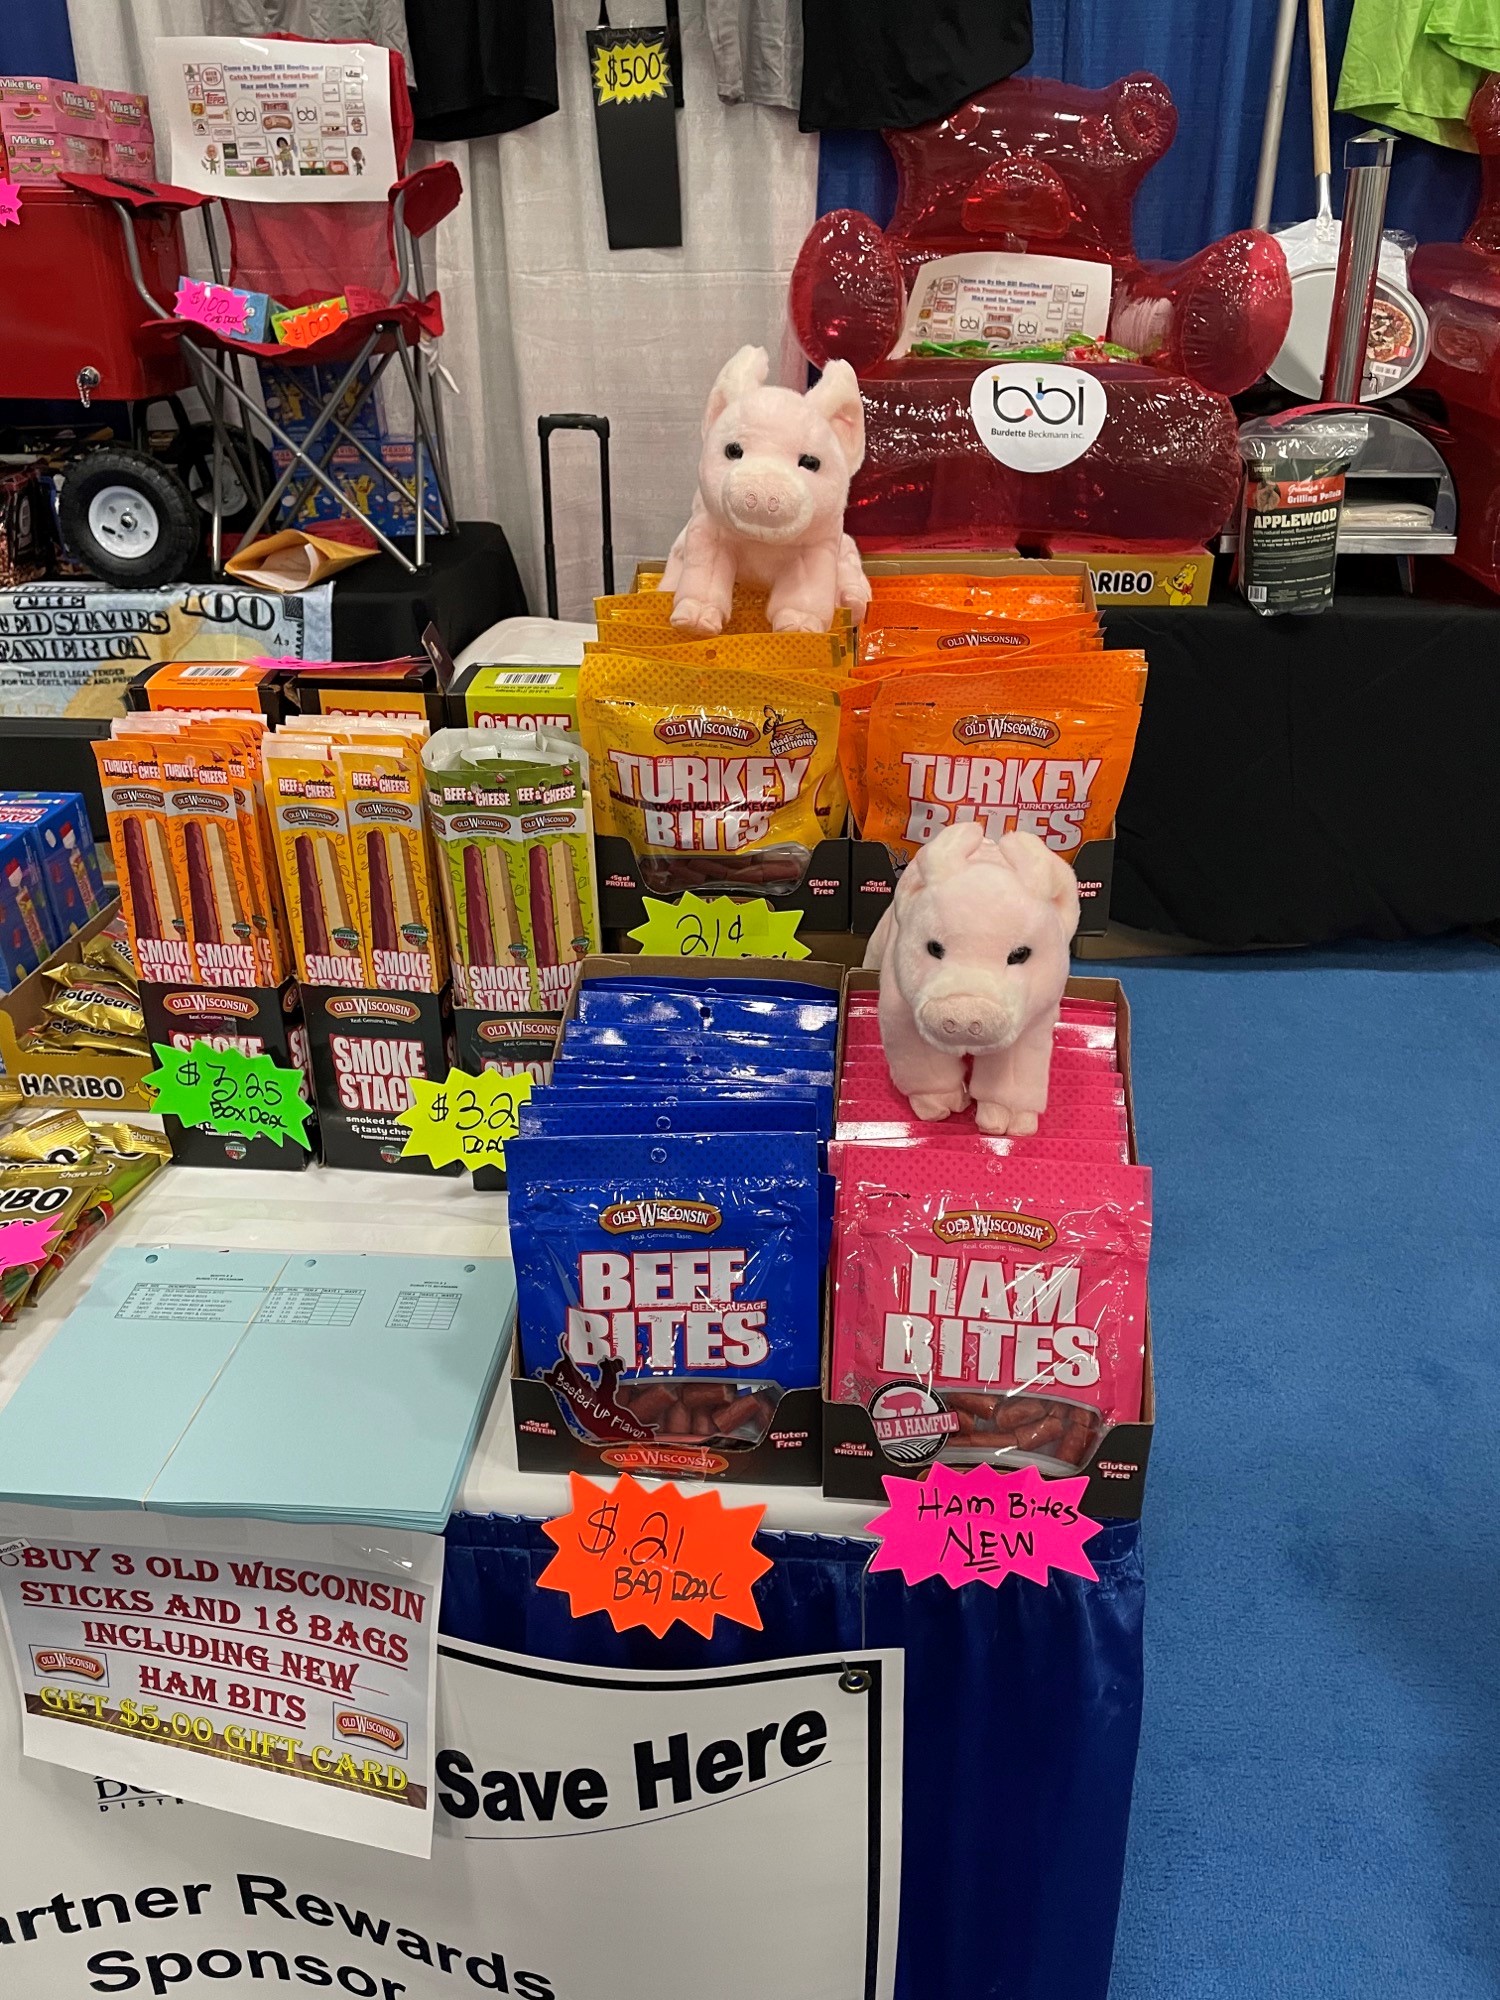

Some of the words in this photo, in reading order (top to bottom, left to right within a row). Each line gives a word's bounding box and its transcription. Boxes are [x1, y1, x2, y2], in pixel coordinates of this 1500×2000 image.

[605, 52, 661, 91] $500
[12, 136, 36, 146] Mike
[991, 375, 1086, 426] bbi
[991, 428, 1026, 438] Burdette
[1028, 430, 1068, 438] Beckmann
[1070, 431, 1084, 439] inc.
[1288, 495, 1317, 504] Grilling
[1320, 490, 1341, 500] Pellets
[1254, 508, 1338, 528] APPLEWOOD
[13, 595, 86, 610] THE
[180, 588, 275, 630] 100
[10, 637, 151, 661] AMERICA
[948, 636, 964, 646] OLD
[965, 634, 1020, 646] WISCONSIN
[666, 724, 686, 736] OLD
[687, 718, 748, 740] WISCONSIN
[770, 734, 794, 748] Made
[795, 732, 814, 740] with
[965, 724, 986, 736] OLD
[987, 718, 1049, 740] WISCONSIN
[772, 744, 792, 756] REAL
[791, 738, 817, 748] HONEY
[352, 772, 372, 787] BEEF
[379, 779, 410, 793] CHEESE
[610, 751, 810, 803] TURKEY
[903, 753, 1101, 804] TURKEY
[279, 779, 298, 792] BEEF
[306, 786, 336, 799] CHEESE
[444, 788, 466, 801] BEEF
[476, 793, 511, 806] CHEESE
[1053, 802, 1090, 810] SAUSAGE
[646, 810, 772, 852] BITES
[903, 800, 1085, 850] BITES
[606, 880, 636, 888] PROTEIN
[808, 879, 839, 887] Gluten
[814, 887, 834, 895] Free
[195, 942, 256, 969] SMOKE
[373, 950, 432, 977] SMOKE
[201, 969, 257, 987] STACK
[306, 954, 364, 981] SMOKE
[468, 966, 531, 991] SMOKE
[377, 974, 431, 993] STACK
[172, 998, 190, 1009] OLD
[189, 994, 248, 1012] WISCONSIN
[334, 1002, 352, 1011] OLD
[352, 998, 410, 1016] WISCONSIN
[473, 990, 531, 1011] STACK
[488, 1024, 506, 1035] OLD
[332, 1037, 425, 1078] SMOKE
[20, 1076, 123, 1098] HARIBO
[346, 1116, 384, 1125] smoked
[613, 1210, 636, 1226] OLD
[636, 1202, 710, 1227] WISCONSIN
[946, 1220, 970, 1234] OLD
[971, 1215, 1043, 1242] WISCONSIN
[580, 1250, 745, 1310] BEEF
[908, 1254, 1081, 1324] HAM
[692, 1303, 715, 1312] BEEF
[718, 1301, 767, 1312] SAUSAGE
[568, 1308, 768, 1368] BITES
[880, 1312, 1100, 1388] BITES
[520, 1424, 556, 1435] PROTEIN
[611, 1416, 647, 1438] Flavor
[769, 1431, 808, 1440] Gluten
[894, 1420, 904, 1436] A
[904, 1414, 956, 1434] HAMFUL
[776, 1440, 802, 1448] Free
[834, 1449, 873, 1457] PROTEIN
[614, 1453, 638, 1462] OLD
[638, 1451, 715, 1468] WISCONSIN
[1099, 1461, 1138, 1471] Gluten
[1103, 1471, 1130, 1480] Free
[940, 1522, 1034, 1562] NEW
[22, 1546, 100, 1572] BUY
[113, 1553, 135, 1575] 3
[146, 1556, 219, 1582] OLD
[228, 1560, 426, 1624] WISCONSIN
[20, 1580, 154, 1612] STICKS
[167, 1593, 241, 1624] AND
[255, 1605, 298, 1636] 18
[308, 1614, 409, 1664] BAGS
[40, 1654, 56, 1666] OLD
[55, 1651, 97, 1673] WISCONSIN
[82, 1620, 271, 1672] INCLUDING
[280, 1649, 360, 1694] NEW
[139, 1664, 216, 1705] HAM
[228, 1686, 307, 1724] BITS
[40, 1686, 110, 1719] GET
[118, 1698, 214, 1743] $5.00
[224, 1724, 303, 1763] GIFT
[311, 1745, 409, 1791] CARD
[342, 1715, 356, 1728] OLD
[355, 1715, 397, 1740] WISCONSIN
[436, 1749, 608, 1822] Save
[633, 1710, 828, 1811] Here
[236, 1873, 556, 1999] Rewards
[86, 1948, 406, 2000] Sponsor
